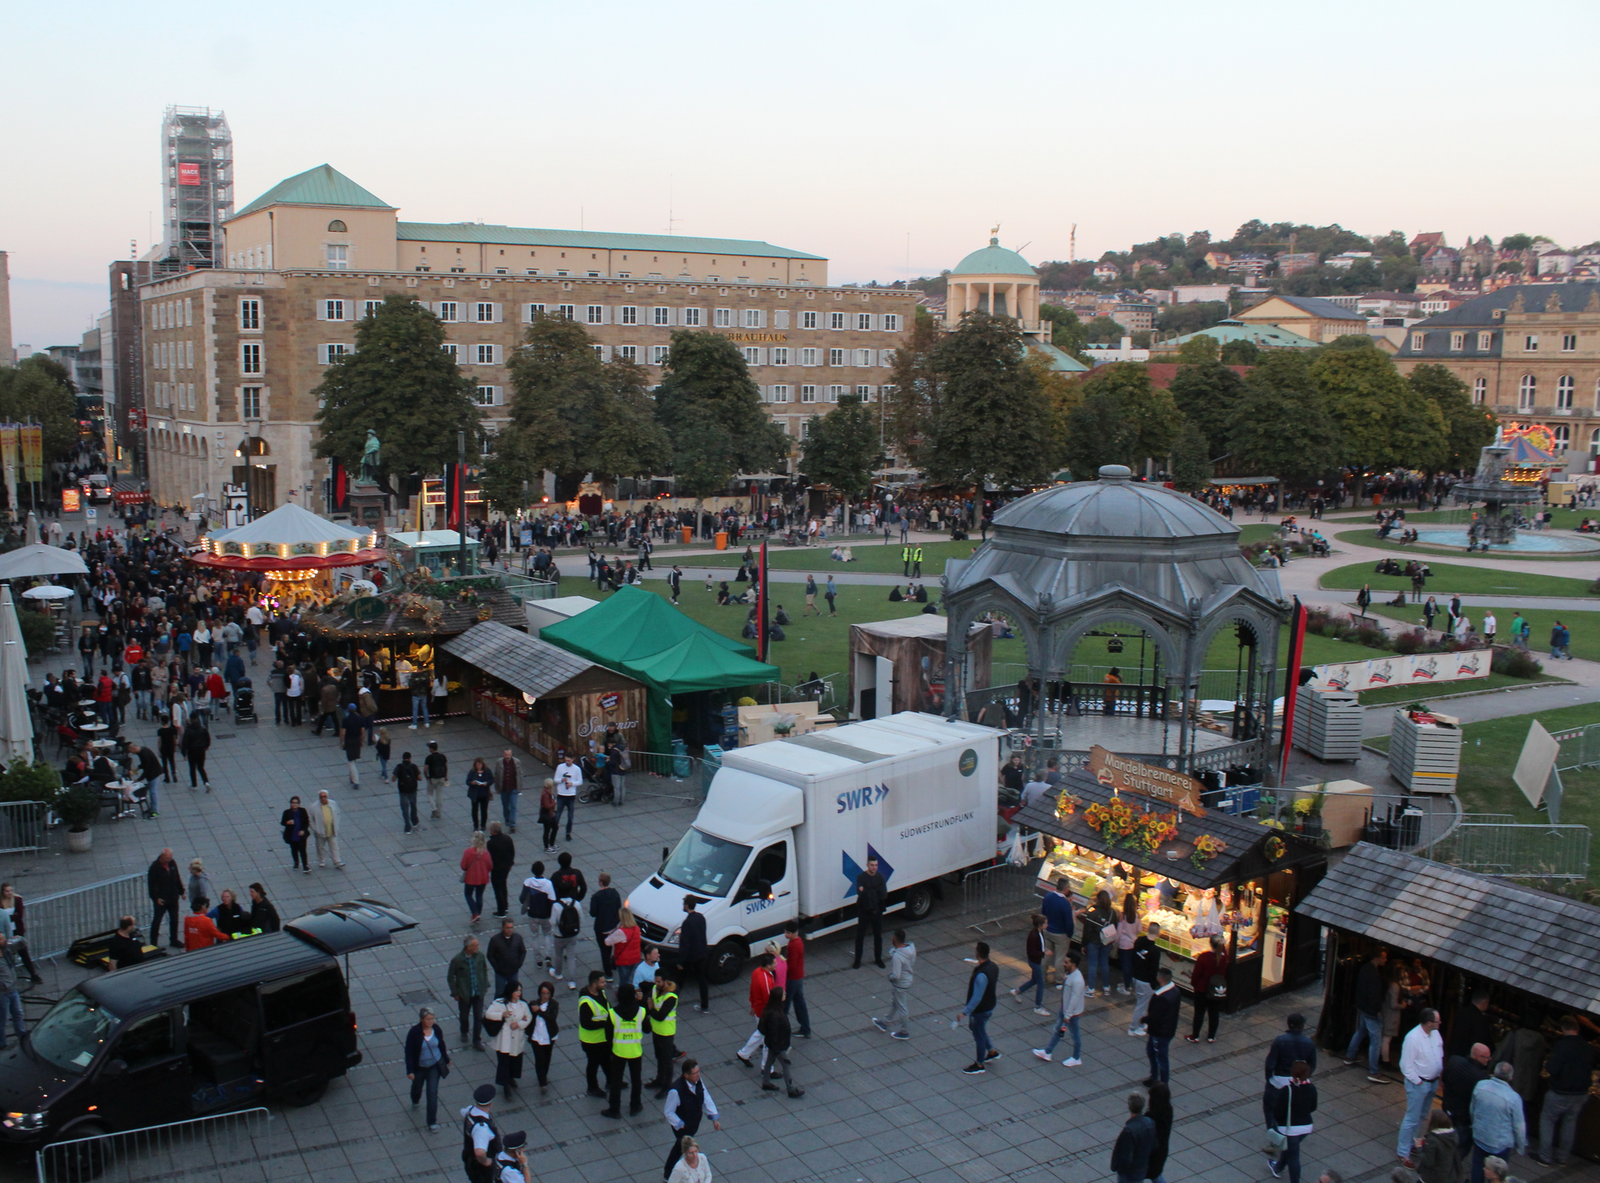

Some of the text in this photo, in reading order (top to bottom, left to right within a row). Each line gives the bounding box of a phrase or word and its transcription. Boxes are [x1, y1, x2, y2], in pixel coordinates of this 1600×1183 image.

[727, 332, 788, 342] BRAUHAUS
[215, 431, 225, 468] ONLY
[577, 716, 639, 738] Sounirs
[1104, 753, 1192, 791] Mandelbrennerei
[1122, 774, 1174, 798] Stuttgart
[836, 786, 873, 814] SWR
[899, 811, 974, 840] SÜDWESTRUNDFUNK
[746, 899, 767, 915] SWR
